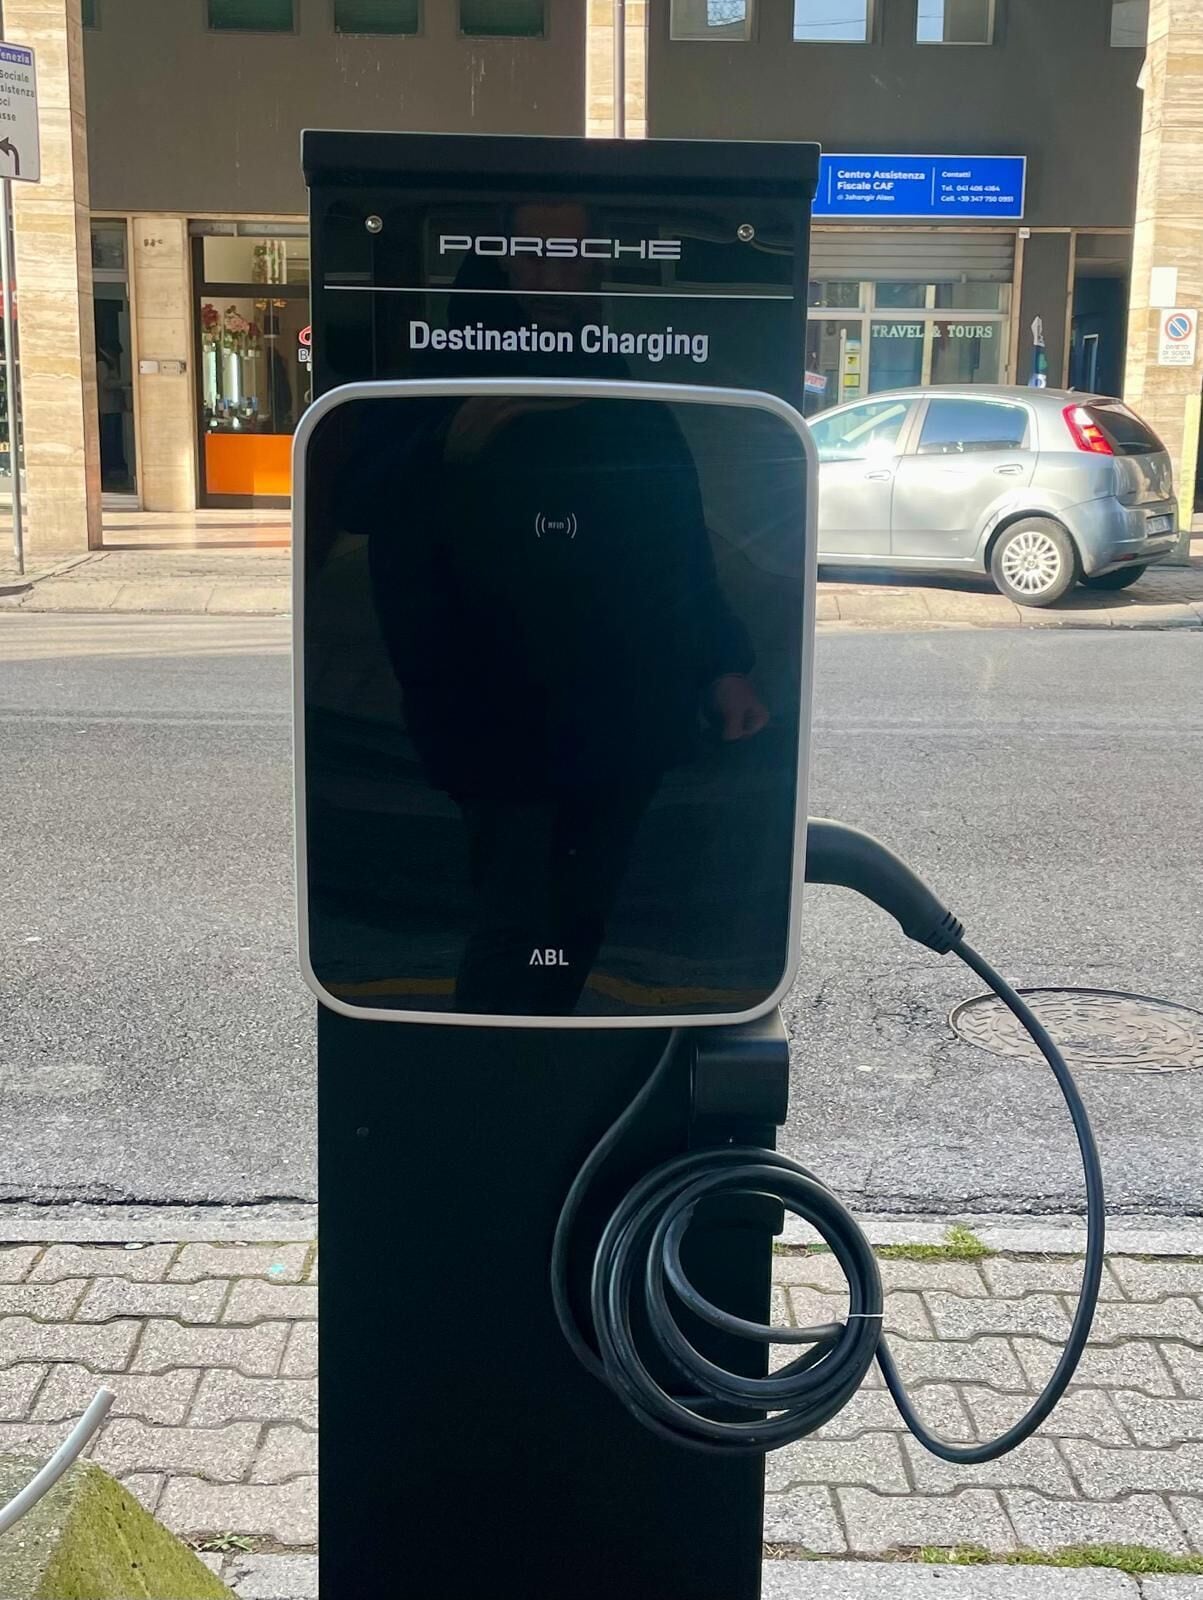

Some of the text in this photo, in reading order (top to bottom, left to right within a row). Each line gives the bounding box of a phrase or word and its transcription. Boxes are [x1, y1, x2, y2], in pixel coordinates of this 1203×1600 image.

[0, 49, 30, 63] enezia
[837, 170, 925, 180] Centro Assistenza
[837, 181, 894, 191] Fiscale CAF
[438, 234, 682, 260] PORSCHE
[871, 325, 993, 338] TRAVEL & TOURS
[409, 320, 709, 363] Destination Charging
[529, 948, 569, 966] ABL
